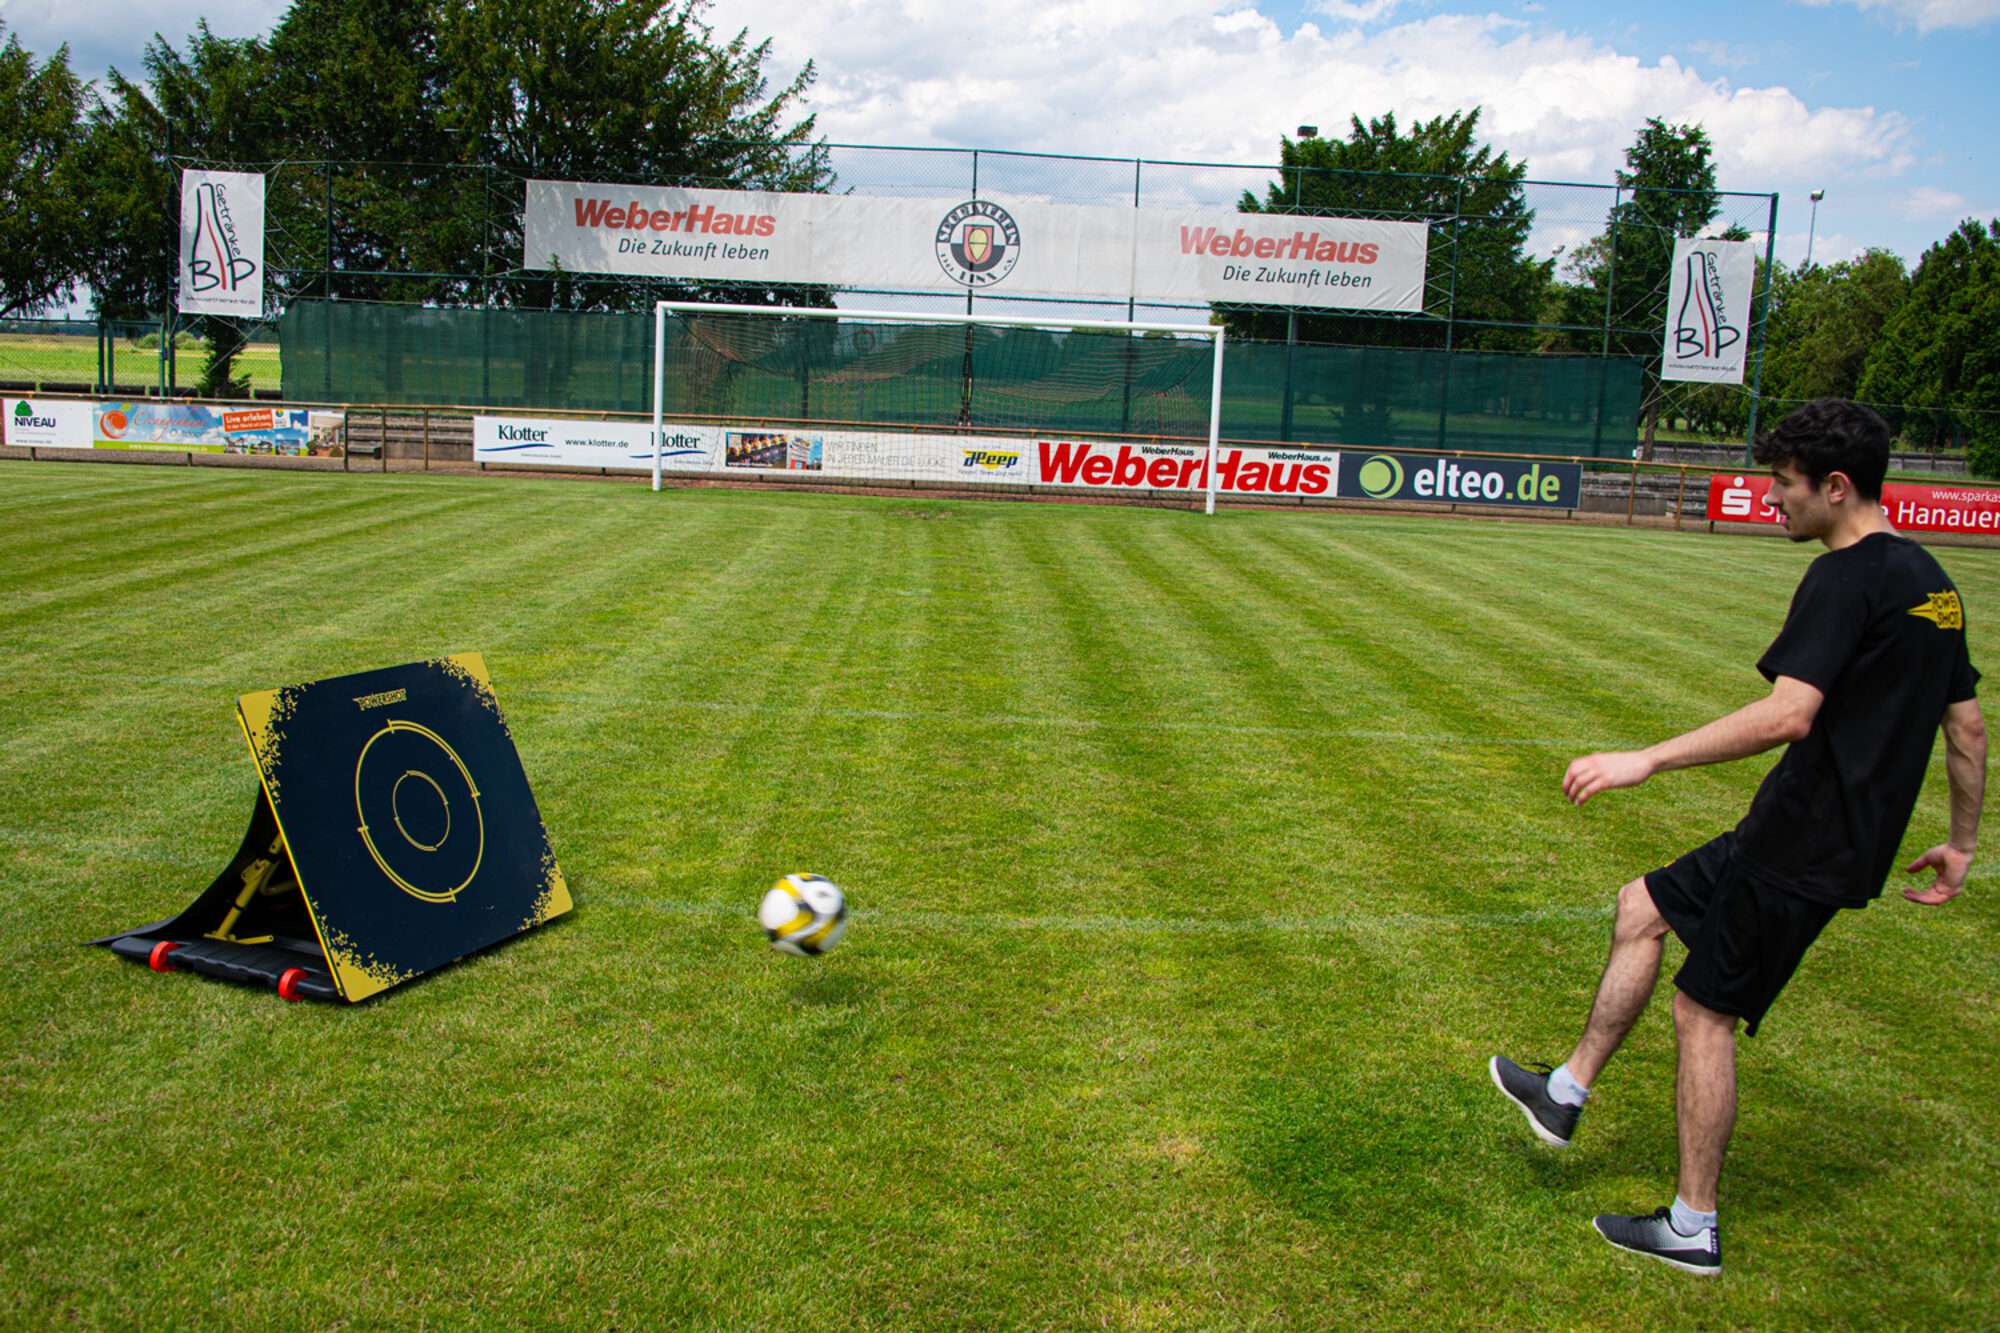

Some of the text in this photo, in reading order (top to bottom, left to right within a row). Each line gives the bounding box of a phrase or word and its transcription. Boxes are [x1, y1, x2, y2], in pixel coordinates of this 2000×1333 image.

[215, 183, 241, 258] Getränke
[575, 198, 777, 237] WeberHaus
[618, 238, 769, 262] Die Zukunft leben
[1180, 226, 1380, 265] WeberHaus
[1222, 266, 1372, 288] Die Zukunft leben
[1706, 251, 1727, 325] Getränke
[15, 416, 56, 428] NIVEAU
[498, 424, 549, 442] Klotter
[565, 438, 629, 449] www.klotter.de
[650, 431, 700, 449] lotter
[1141, 445, 1195, 457] WeberHaus
[1038, 442, 1331, 494] WeberHaus
[1267, 451, 1333, 463] WeberHaus.de
[1414, 459, 1561, 502] elteo.de
